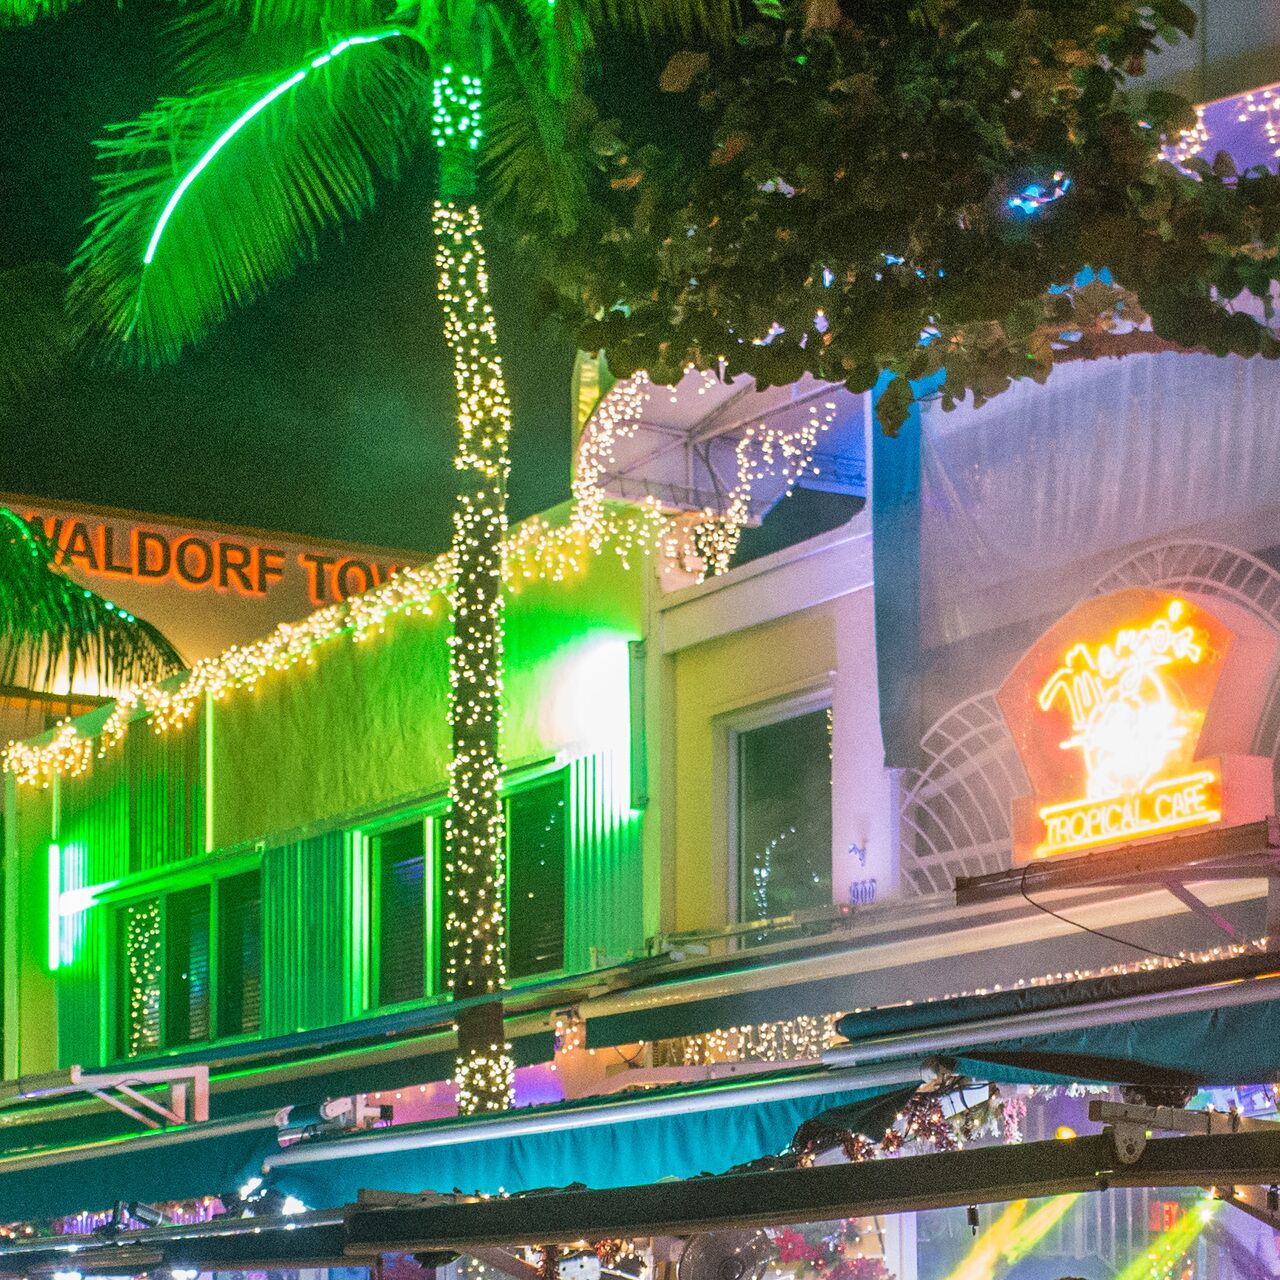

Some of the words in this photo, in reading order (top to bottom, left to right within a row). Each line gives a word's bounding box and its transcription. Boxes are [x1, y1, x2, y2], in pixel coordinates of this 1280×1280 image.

[25, 512, 286, 595] WALDORF
[300, 554, 398, 601] TO
[1045, 797, 1151, 845] TROPICAL
[1154, 783, 1206, 822] CAFE
